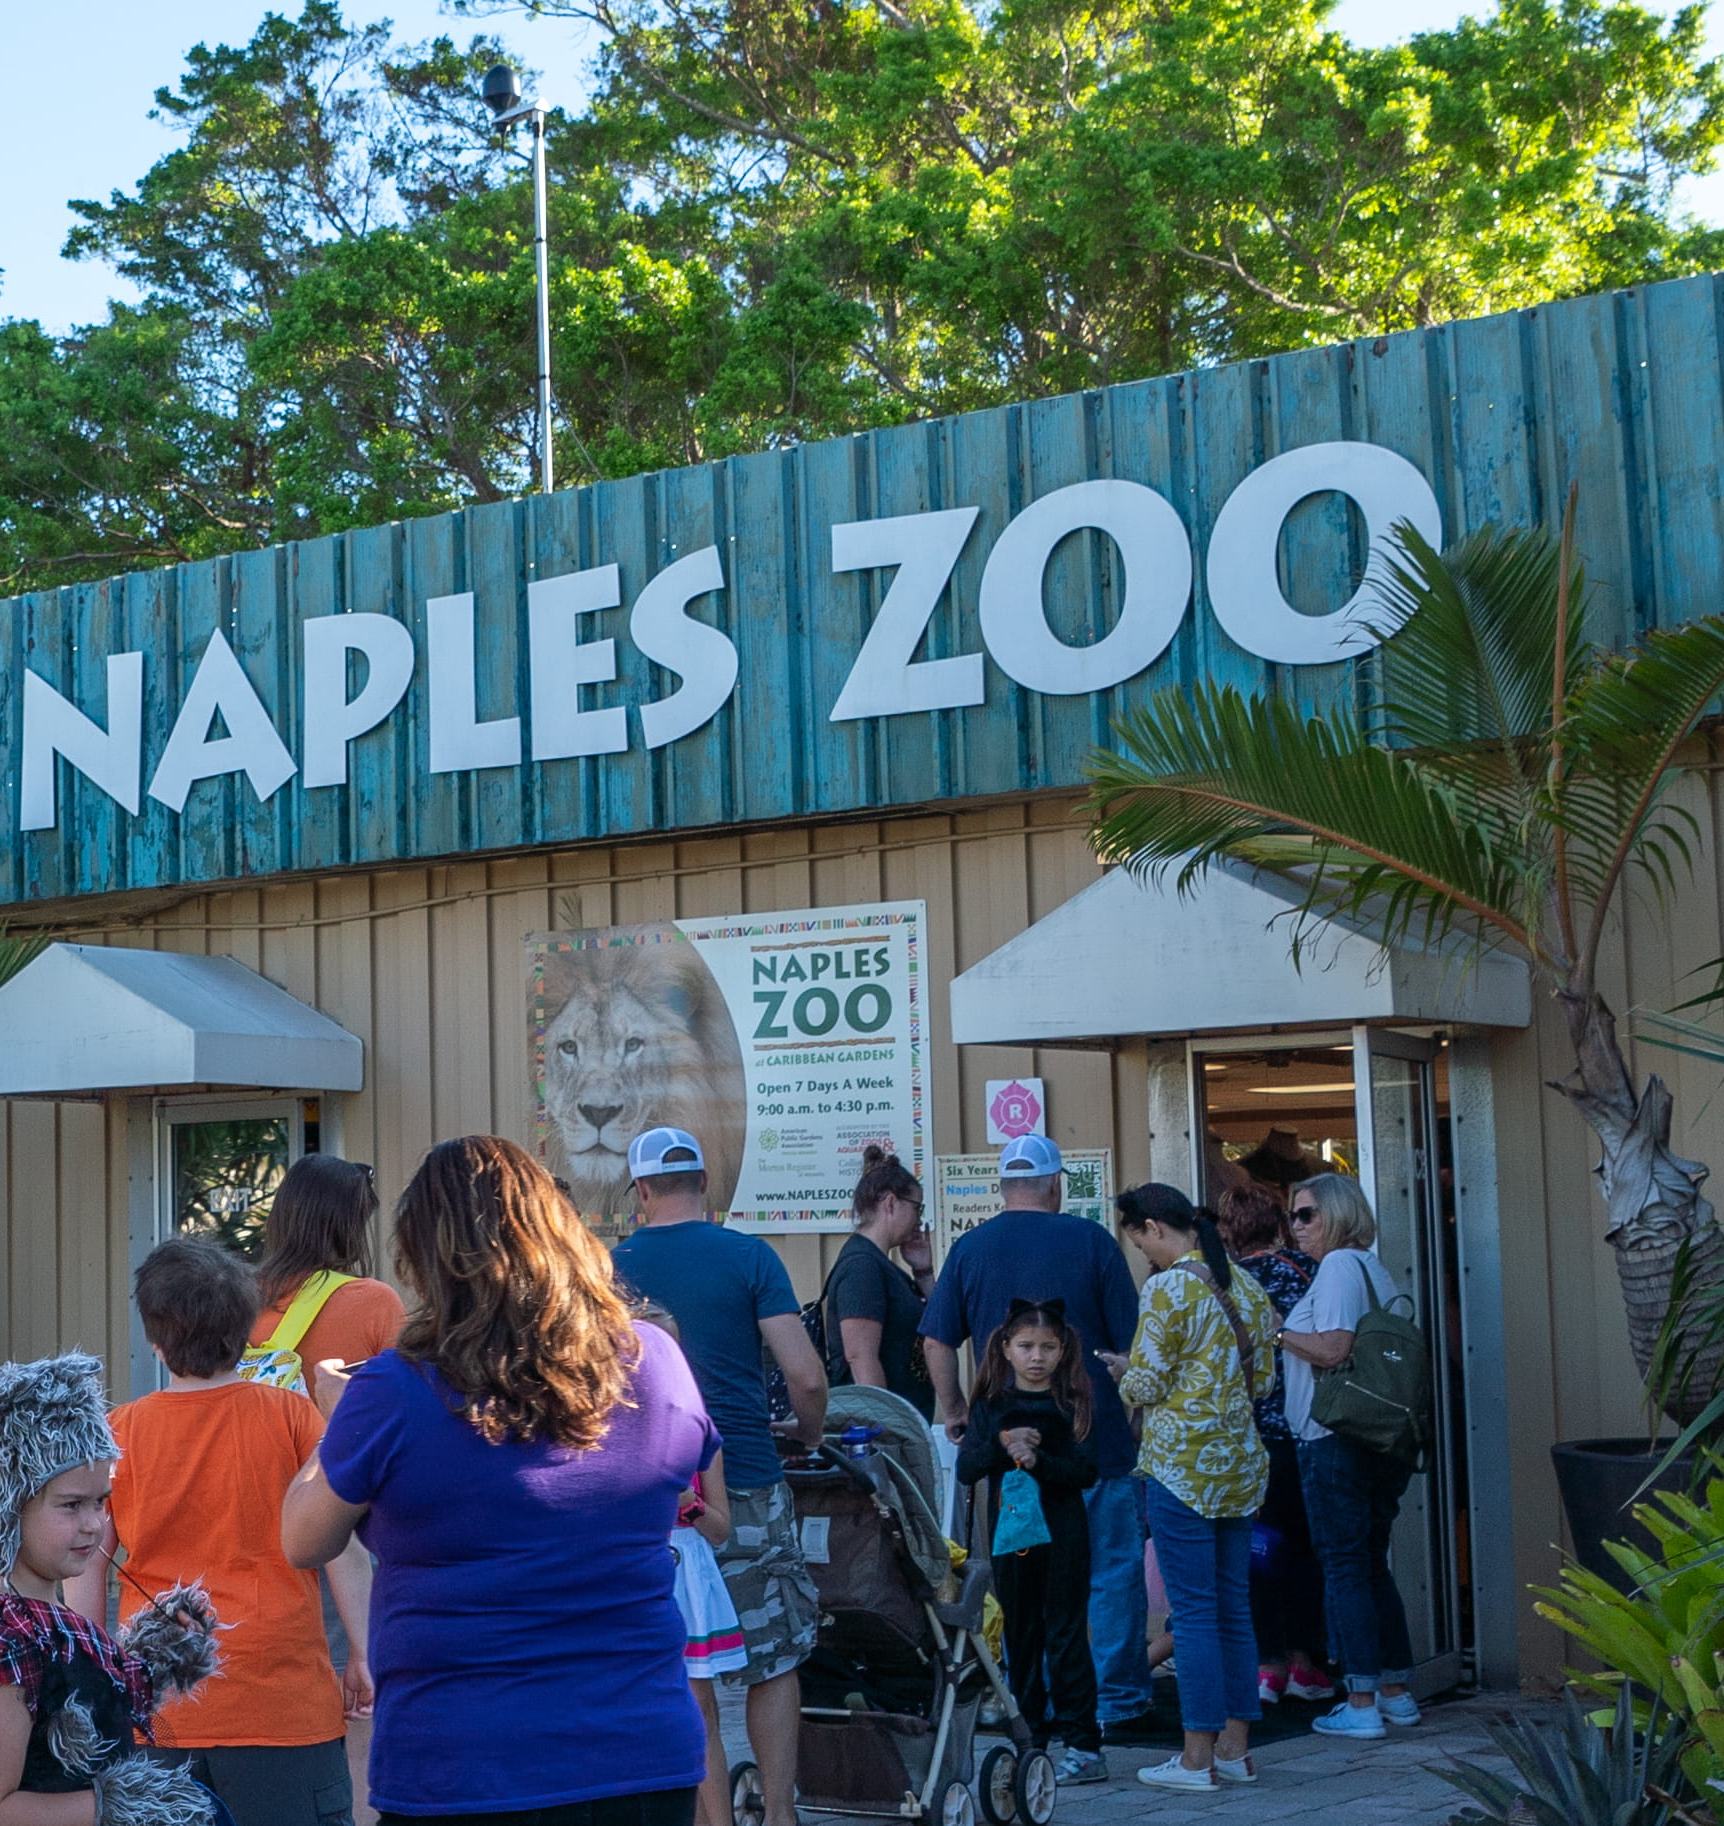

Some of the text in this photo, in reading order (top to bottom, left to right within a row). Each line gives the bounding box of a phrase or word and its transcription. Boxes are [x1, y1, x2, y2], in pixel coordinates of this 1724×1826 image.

[20, 441, 1443, 831] NAPLES ZOO
[752, 947, 890, 985] NAPLES
[752, 983, 892, 1039] ZOO
[766, 1052, 834, 1066] CARIBBEAN
[837, 1049, 894, 1062] GARDENS
[757, 1076, 894, 1097] Open 7 Days A Week
[757, 1100, 894, 1116] 9:00 a.m. to 4:30 p.m.
[1009, 1104, 1023, 1119] R
[837, 1131, 890, 1139] ASSOCIATION
[947, 1165, 998, 1176] Six Years
[947, 1184, 988, 1197] Naples
[210, 1187, 252, 1212] EXIT
[953, 1204, 991, 1213] Readers
